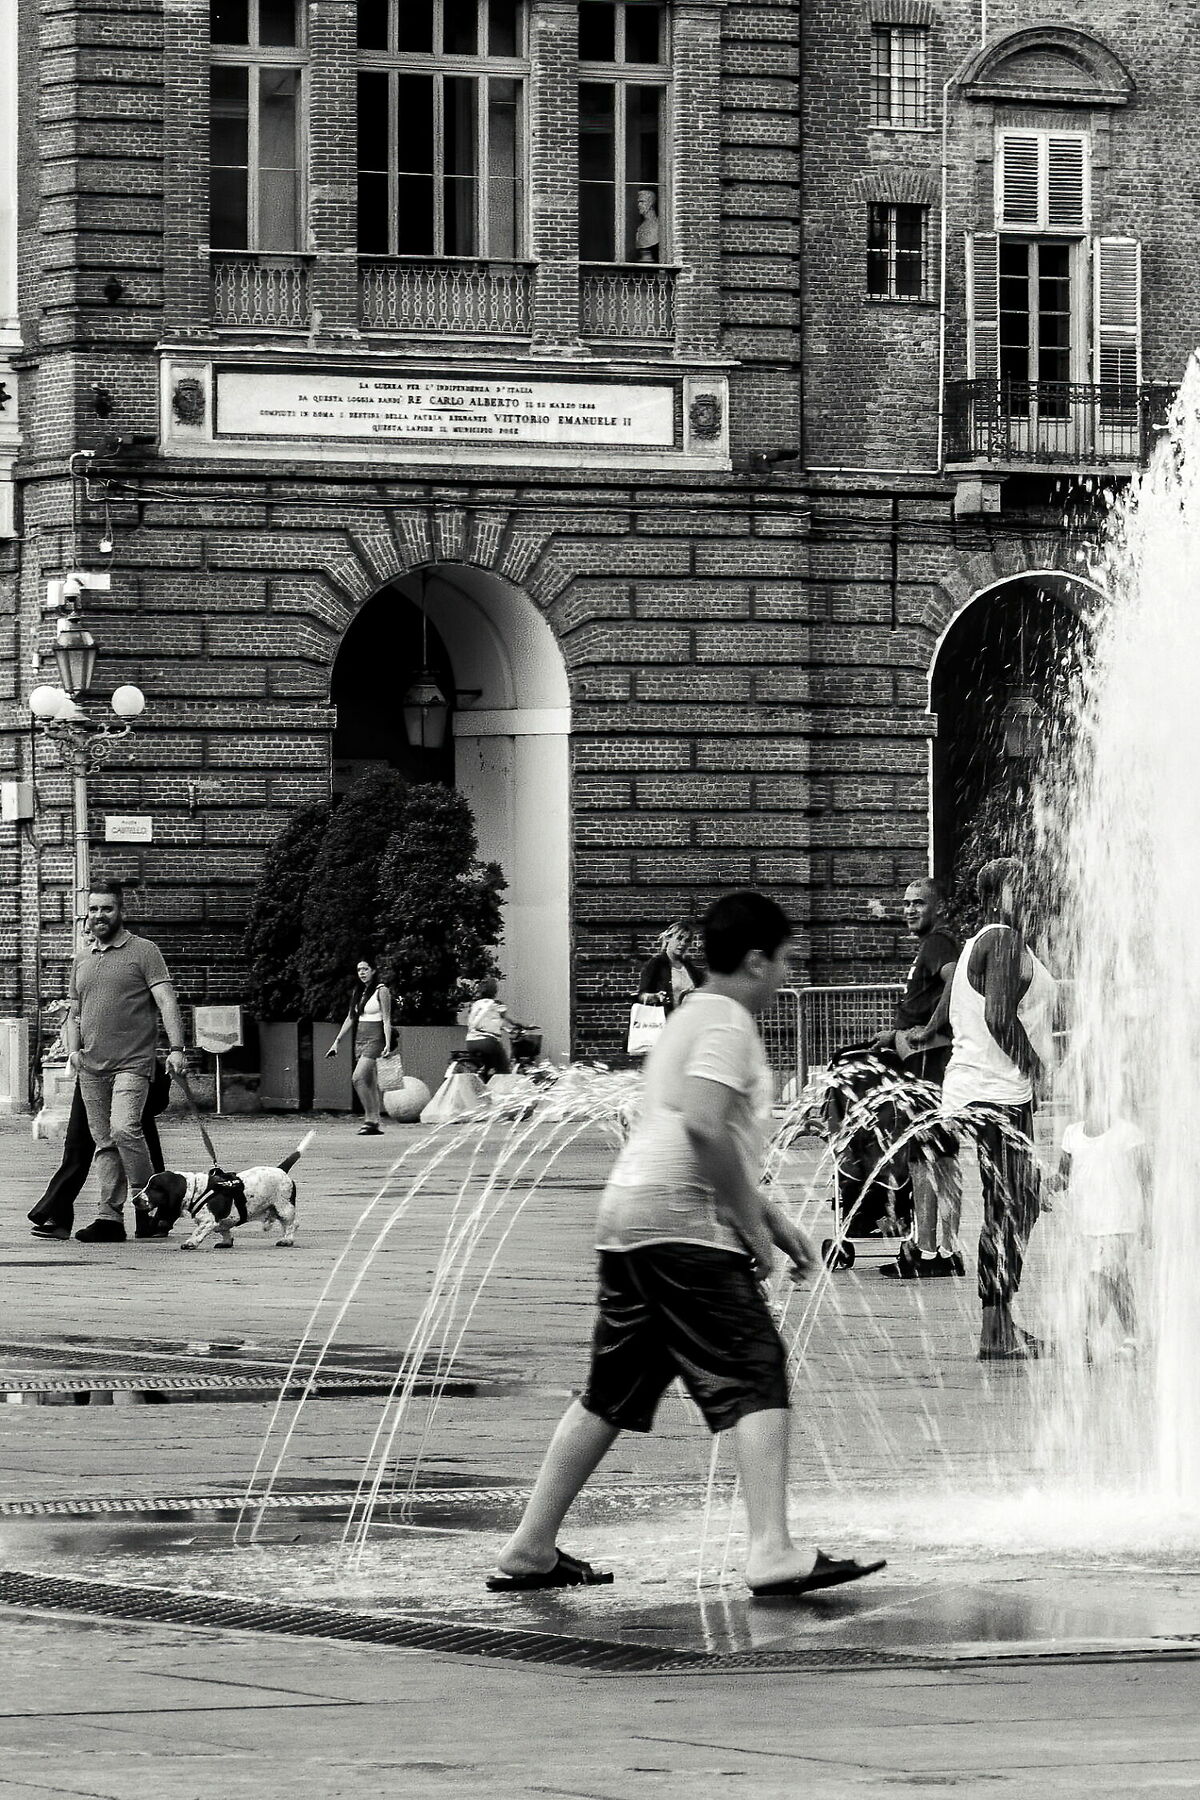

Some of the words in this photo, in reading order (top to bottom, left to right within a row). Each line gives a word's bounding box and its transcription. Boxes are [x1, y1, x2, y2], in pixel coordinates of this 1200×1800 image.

[312, 395, 343, 403] QUESTA
[407, 395, 422, 405] RE
[429, 396, 465, 406] CARLO
[469, 398, 520, 408] ALBERTO
[493, 413, 551, 424] VITTORIO
[557, 416, 618, 426] EMANUELE
[622, 417, 632, 427] II
[372, 425, 403, 433] QUESTA
